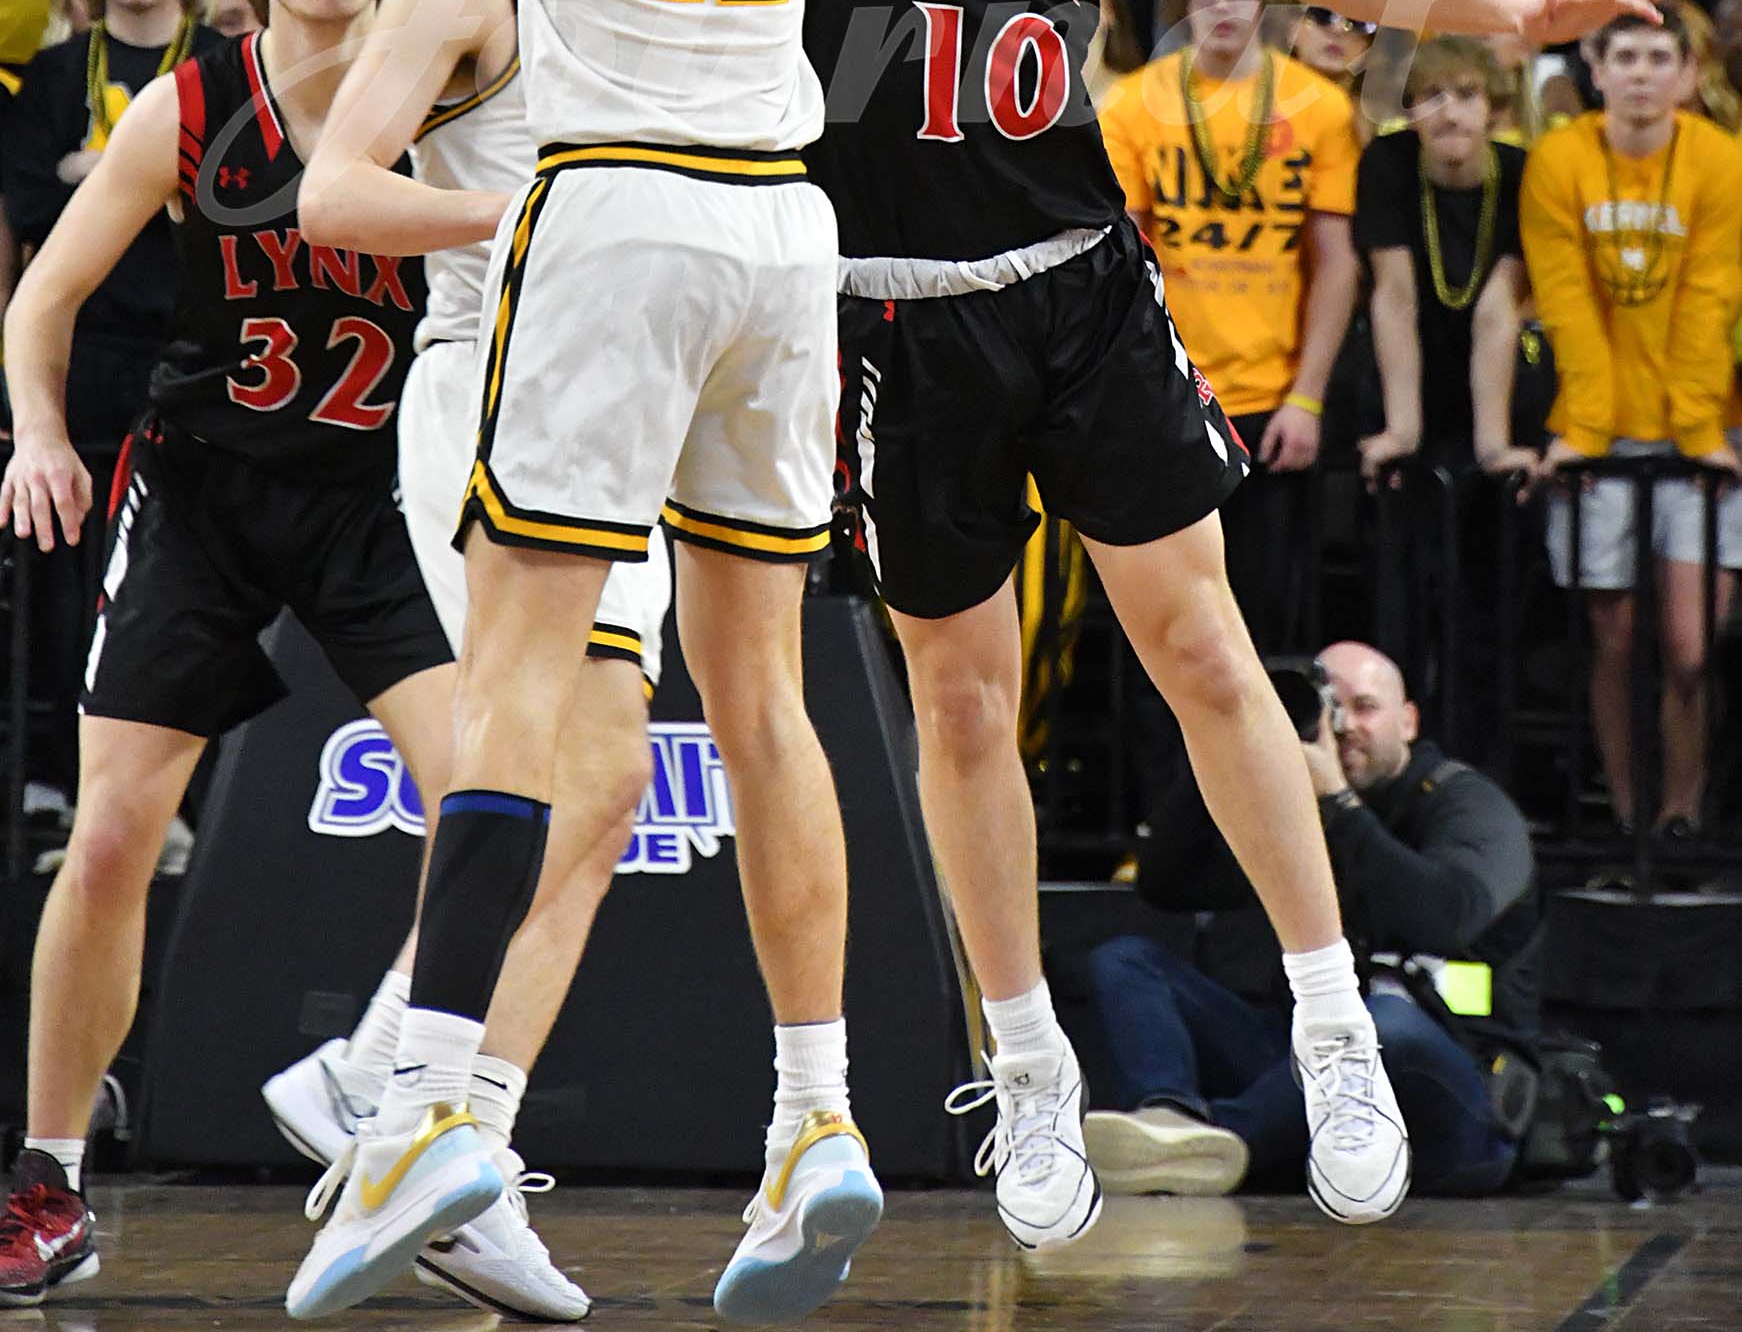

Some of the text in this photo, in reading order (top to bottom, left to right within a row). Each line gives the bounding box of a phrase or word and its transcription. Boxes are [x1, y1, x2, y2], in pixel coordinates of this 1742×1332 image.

[912, 0, 1071, 143] 10
[218, 228, 414, 312] LYNX
[226, 316, 396, 431] 32
